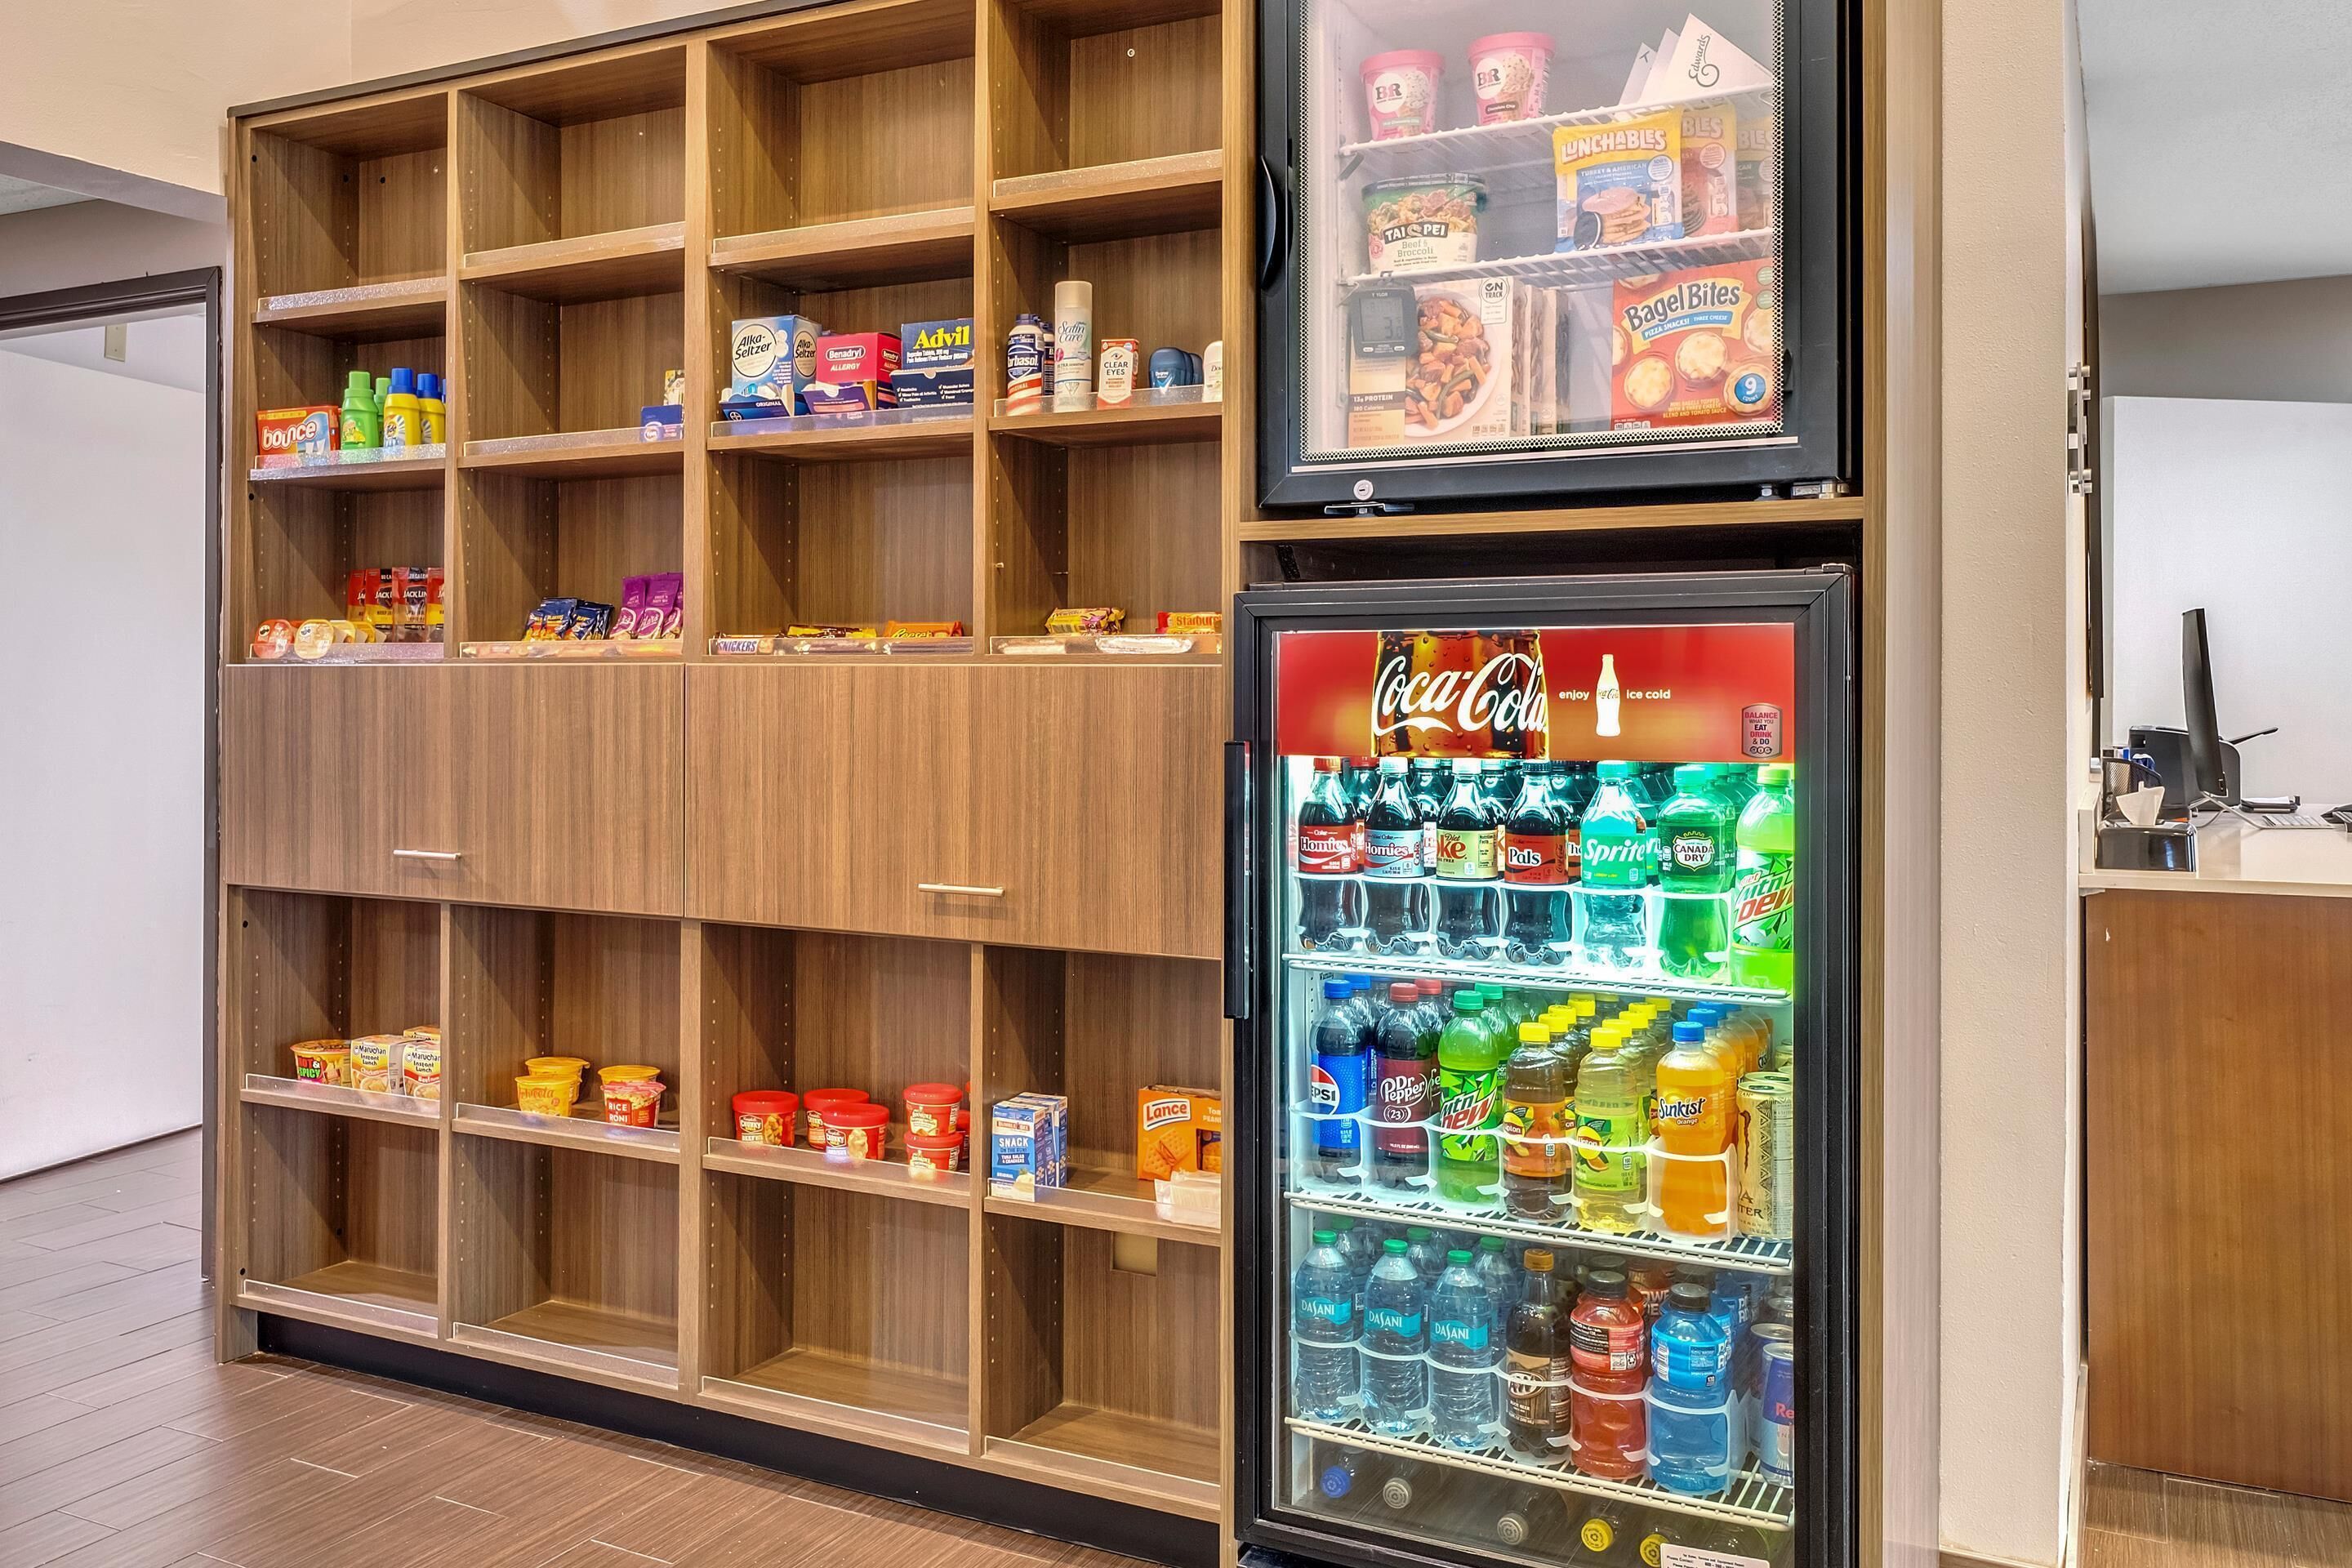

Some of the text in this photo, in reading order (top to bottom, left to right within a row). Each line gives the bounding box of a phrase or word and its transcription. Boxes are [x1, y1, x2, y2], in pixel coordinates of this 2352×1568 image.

[1688, 34, 1719, 87] Edwards
[1561, 129, 1667, 163] LUNCHABLES
[1385, 224, 1446, 241] TAI PEI
[1402, 238, 1422, 248] Beef
[1397, 247, 1433, 257] Broccoli
[1624, 282, 1741, 332] Bagel Bites
[1058, 320, 1085, 337] Satin
[1644, 326, 1664, 338] PIZZA
[1664, 318, 1690, 331] SNACKS!
[737, 334, 766, 349] Alka-
[912, 324, 970, 350] Advil
[734, 342, 773, 360] Seltzer
[795, 349, 816, 359] Seltzer
[829, 349, 862, 359] Benadryl
[831, 363, 861, 372] ALLERGY
[1745, 376, 1757, 395] 9
[262, 421, 317, 450] bounce
[375, 590, 390, 599] JACK
[403, 590, 417, 599] JACK
[719, 640, 757, 653] SNICKERS
[1373, 653, 1548, 737] Coca-Cola
[1558, 689, 1590, 701] enjoy
[1645, 688, 1671, 699] cold
[1300, 836, 1348, 853] Homies
[1444, 833, 1461, 842] Diet
[1365, 843, 1409, 857] Homies
[1437, 835, 1468, 859] ke
[1584, 839, 1646, 866] Sprite
[1674, 844, 1715, 854] CANADA
[1508, 848, 1540, 866] Pals
[1684, 853, 1705, 862] DRY
[359, 1045, 386, 1055] Maruchan
[297, 1056, 312, 1067] HOT
[299, 1067, 320, 1079] SPICY
[1395, 1075, 1415, 1088] Dr
[519, 1087, 555, 1099] elveeta
[1312, 1085, 1336, 1102] EPSI
[1380, 1077, 1426, 1104] Pepper
[608, 1102, 627, 1111] RICE
[1146, 1103, 1187, 1122] Lance
[1659, 1097, 1707, 1120] Sunkist
[609, 1113, 628, 1123] RONI
[1202, 1115, 1221, 1124] PEAN
[1390, 1109, 1402, 1120] 23
[999, 1137, 1029, 1147] SNACK
[1301, 1299, 1334, 1316] DASANI
[1369, 1311, 1402, 1328] DASANI
[1435, 1322, 1469, 1340] DASANI
[1775, 1402, 1794, 1419] Re
